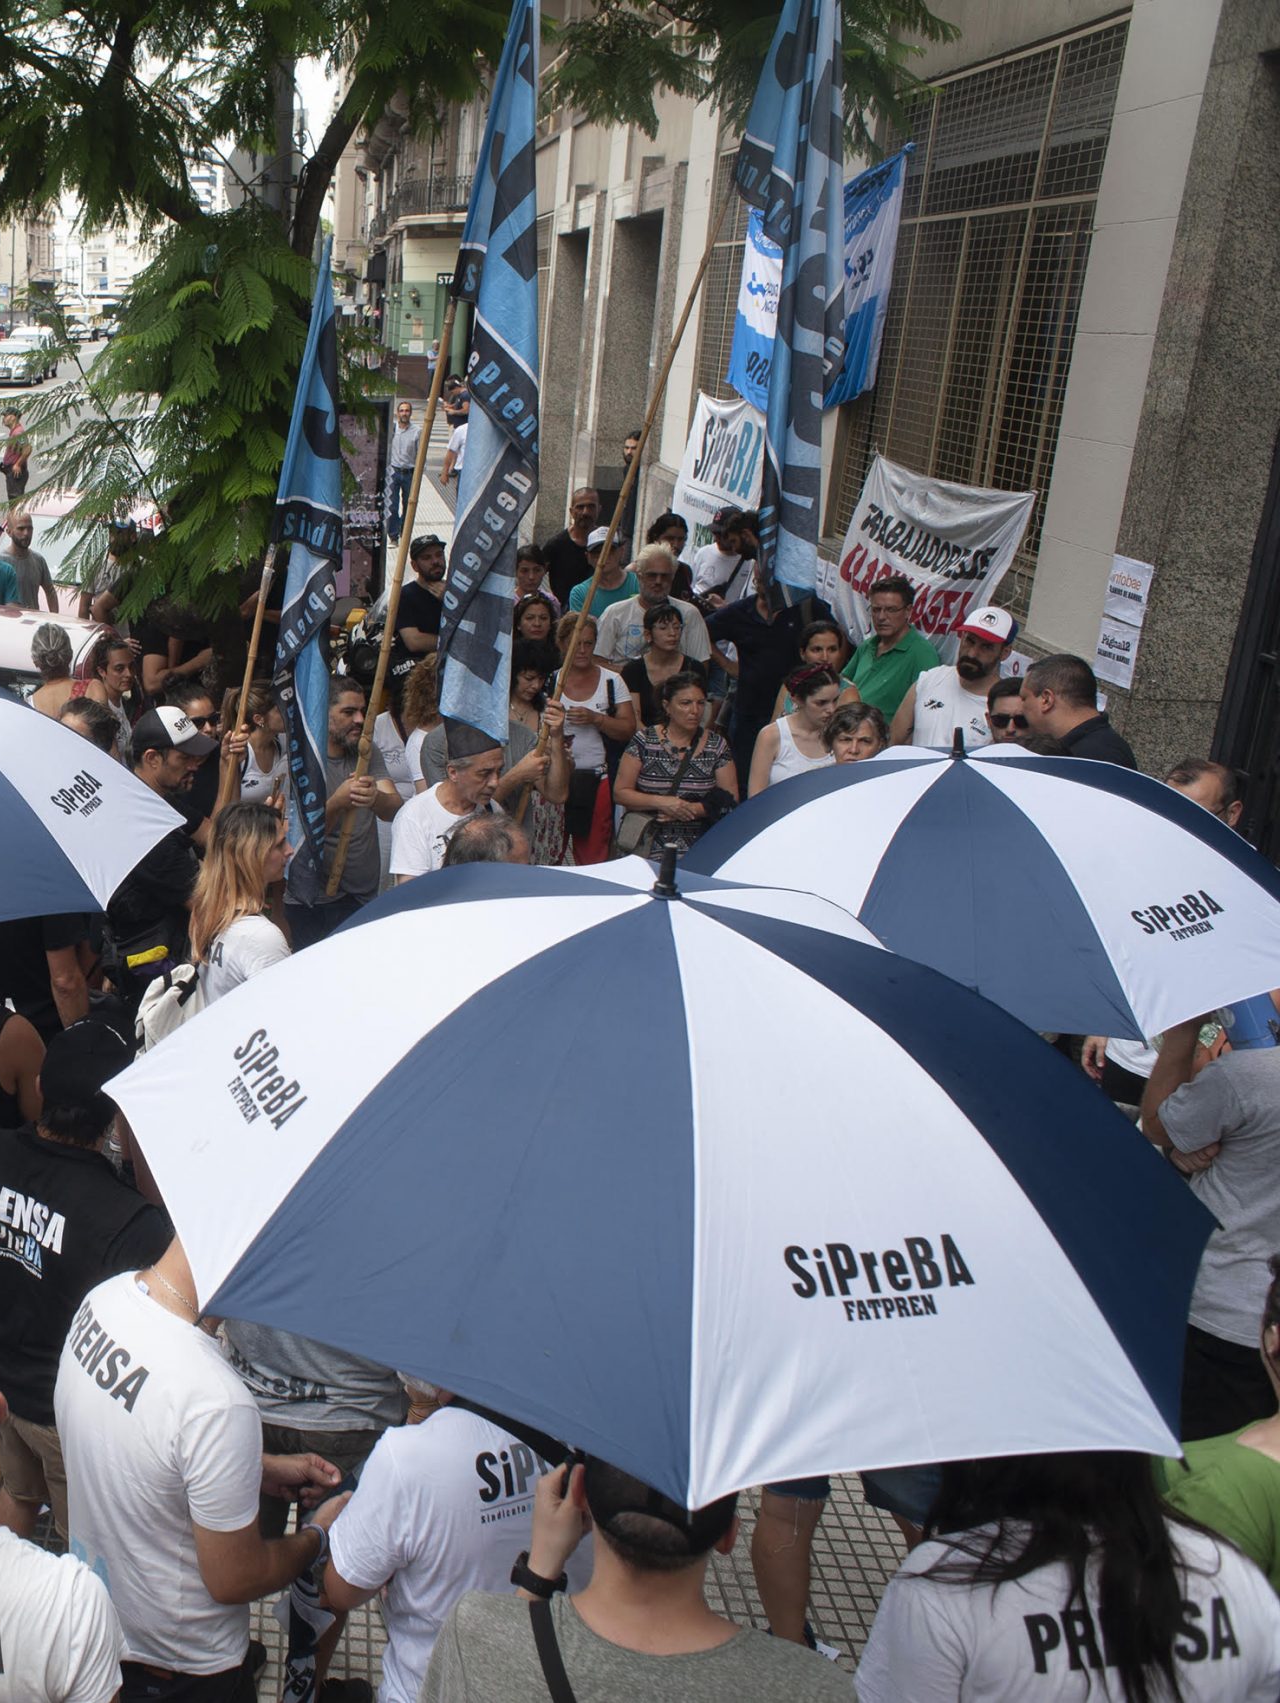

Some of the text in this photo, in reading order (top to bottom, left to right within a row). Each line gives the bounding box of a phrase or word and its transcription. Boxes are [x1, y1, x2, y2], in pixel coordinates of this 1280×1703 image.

[50, 769, 103, 816] SiPreBA
[79, 796, 104, 818] FATPREN
[1130, 889, 1225, 935] SiPreBA
[1169, 920, 1215, 942] FATPREN
[227, 1076, 262, 1125] FATPREN
[233, 1028, 309, 1131] SiPreBA
[784, 1233, 976, 1299] SiPreBA
[842, 1294, 939, 1322] FATPREN
[71, 1300, 150, 1414] PRENSA
[481, 1503, 526, 1524] Sindicato
[1023, 1596, 1241, 1675] PRSA
